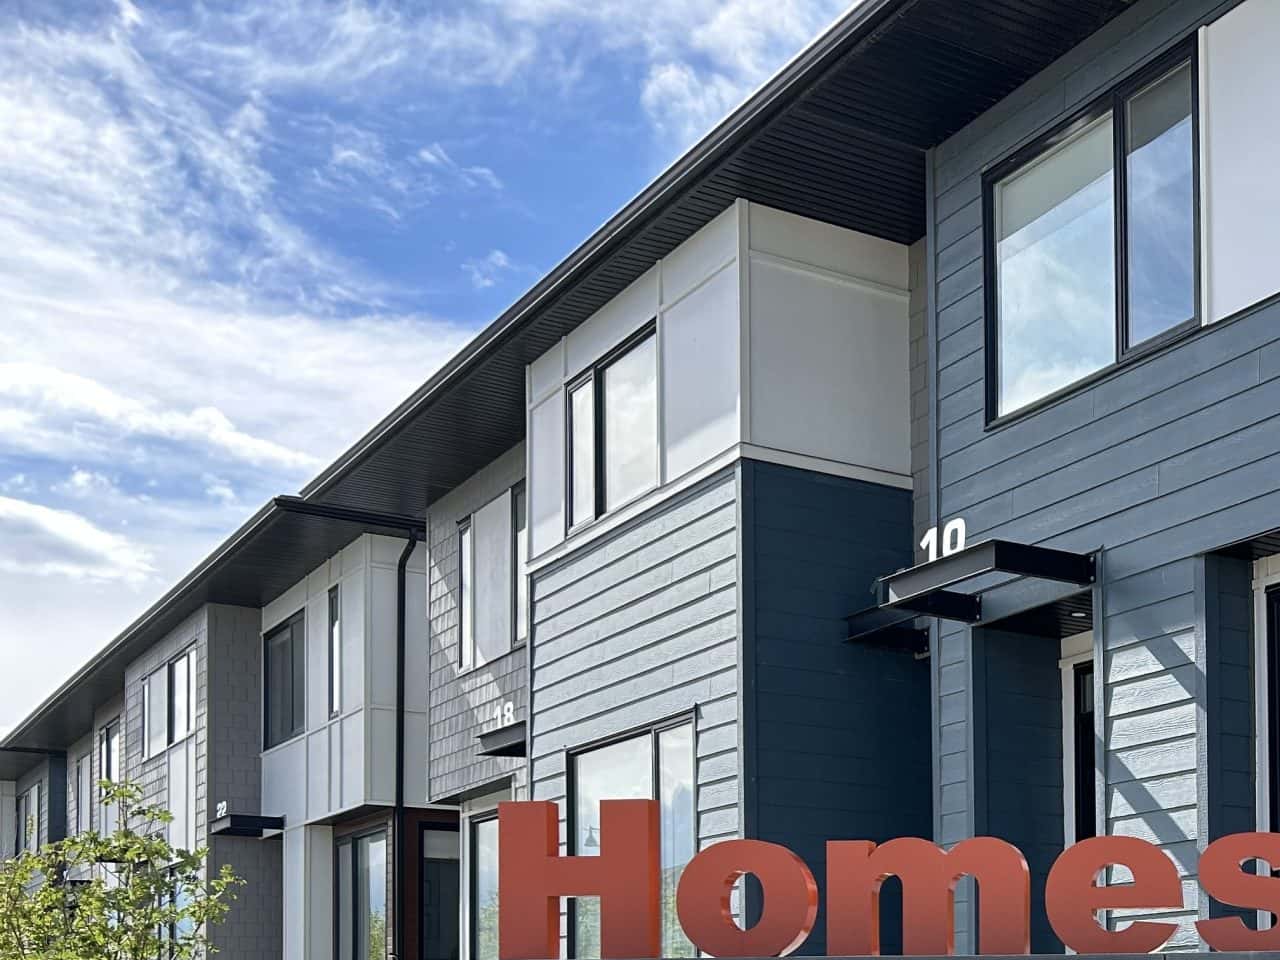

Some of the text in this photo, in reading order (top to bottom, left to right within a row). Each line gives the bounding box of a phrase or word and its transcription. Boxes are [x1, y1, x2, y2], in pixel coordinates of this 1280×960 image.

[919, 517, 966, 562] 10
[493, 701, 514, 728] 18
[216, 800, 228, 819] 22
